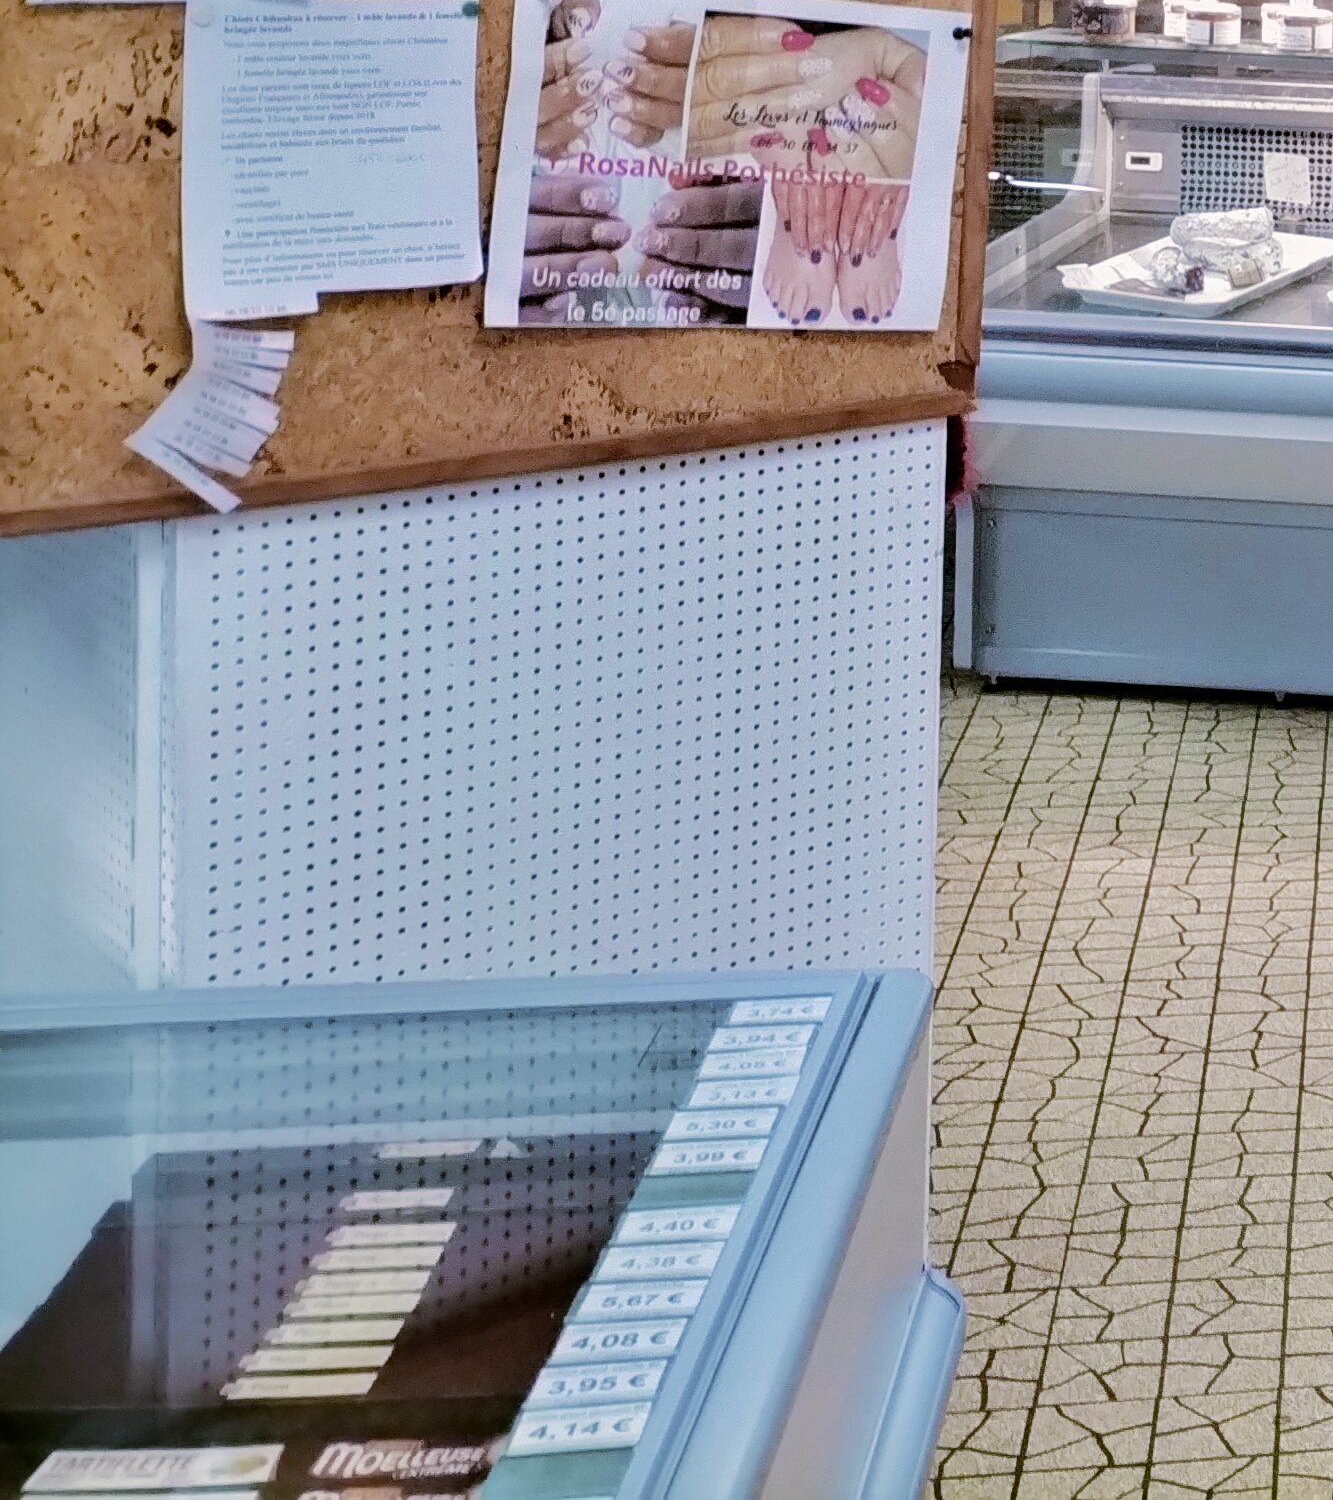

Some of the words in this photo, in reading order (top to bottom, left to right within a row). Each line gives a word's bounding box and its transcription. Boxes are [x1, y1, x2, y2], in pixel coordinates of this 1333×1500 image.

[578, 151, 715, 184] RosaNails
[532, 266, 561, 288] Un
[566, 267, 640, 289] cadeau
[645, 267, 700, 289] offert
[706, 269, 742, 291] dès
[622, 301, 701, 327] passage
[801, 1005, 815, 1015] €
[785, 1031, 801, 1042] €
[774, 1059, 788, 1068] €
[764, 1088, 779, 1098] €
[686, 1119, 737, 1133] 5,30
[743, 1118, 759, 1129] €
[673, 1151, 725, 1165] 3,99
[733, 1150, 748, 1161] €
[640, 1218, 695, 1234] 4,40
[702, 1216, 720, 1230] €
[620, 1255, 677, 1270] 4,38
[685, 1253, 703, 1267] €
[602, 1293, 660, 1310] 5,67
[668, 1291, 686, 1305] €
[571, 1332, 640, 1352] 4,08
[650, 1329, 671, 1346] €
[548, 1375, 619, 1396] 3,95
[628, 1372, 650, 1389] €
[528, 1421, 602, 1440] 4,14
[612, 1417, 634, 1434] €
